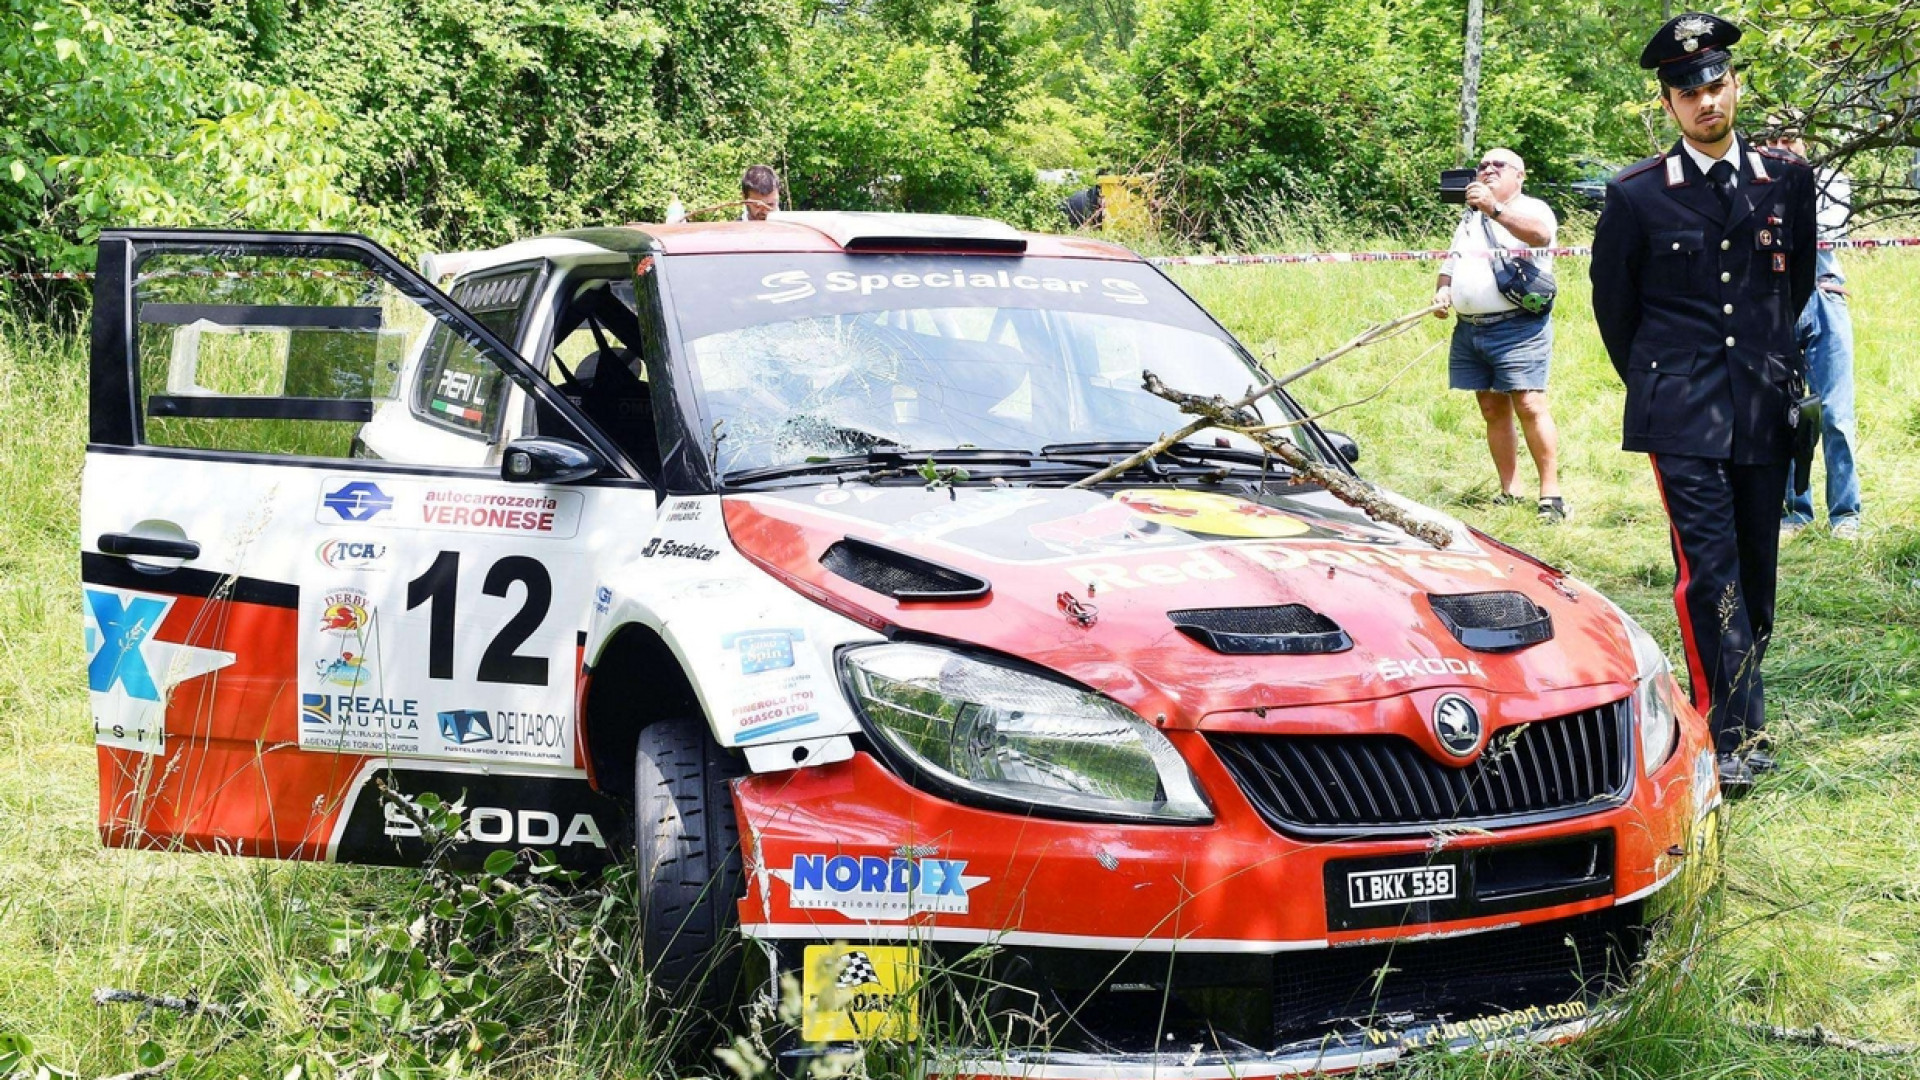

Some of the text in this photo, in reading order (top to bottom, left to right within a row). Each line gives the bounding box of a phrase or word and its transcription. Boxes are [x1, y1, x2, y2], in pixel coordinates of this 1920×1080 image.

[825, 268, 1089, 295] Specialcar
[426, 489, 557, 510] autocarrozzeria
[423, 505, 554, 531] VERONESE
[337, 543, 375, 560] TCA
[658, 539, 721, 561] Specialcar
[1065, 543, 1511, 593] Red Donkey
[324, 593, 369, 607] DERBY
[406, 549, 552, 687] 12
[1377, 658, 1488, 682] ŠKODA
[337, 696, 418, 717] REALE
[732, 690, 814, 716] PINEROLO (TO)
[740, 702, 809, 727] OSASCO (TO)
[337, 714, 419, 730] MUTUA
[496, 710, 566, 749] DELTABOX
[304, 737, 340, 748] AGENZIA
[353, 741, 383, 751] TORINO
[505, 749, 562, 759] FUSTELLATURA
[384, 794, 606, 849] ŠODA
[793, 854, 967, 897] NORDEX
[1354, 870, 1450, 901] 1 BKK 538
[1368, 999, 1587, 1049] wduegisport.com
